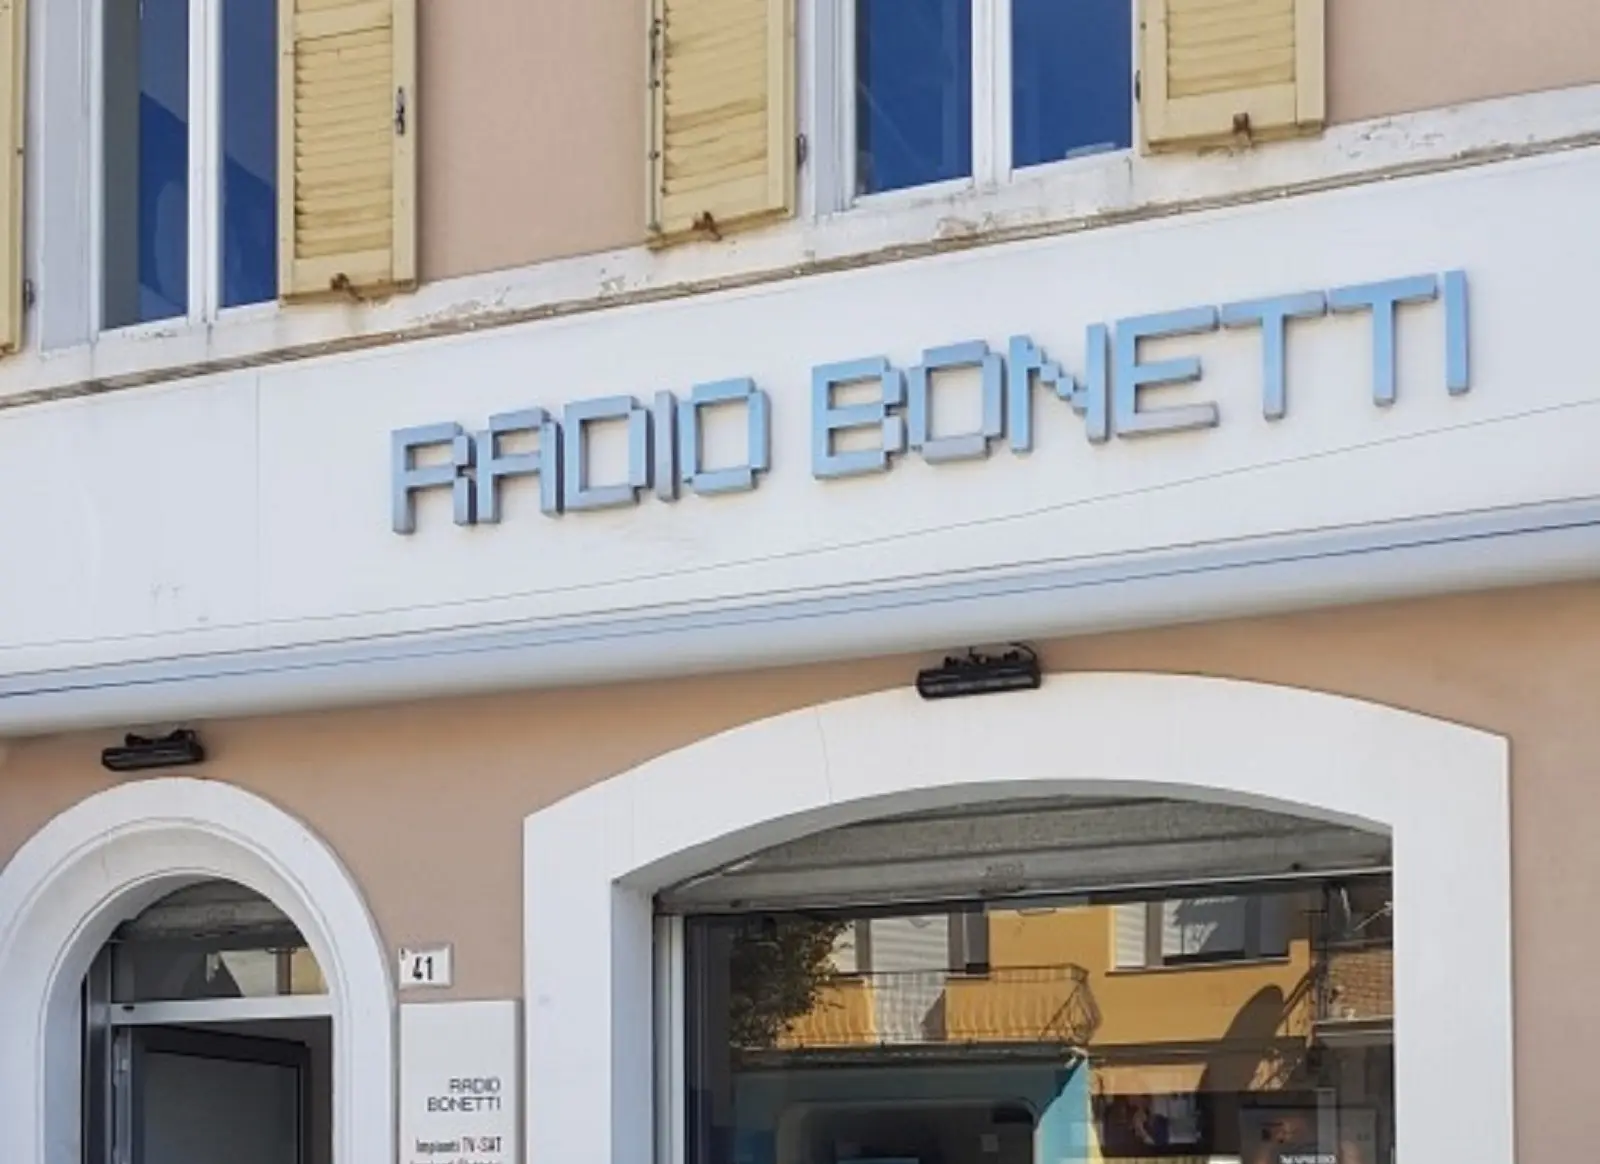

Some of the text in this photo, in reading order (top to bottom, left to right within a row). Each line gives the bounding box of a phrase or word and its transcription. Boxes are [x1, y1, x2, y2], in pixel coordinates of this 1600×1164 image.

[392, 269, 1471, 534] RADIO BONETTI
[412, 956, 433, 980] 41
[449, 1078, 501, 1093] RADIO
[427, 1096, 501, 1112] BONETTI
